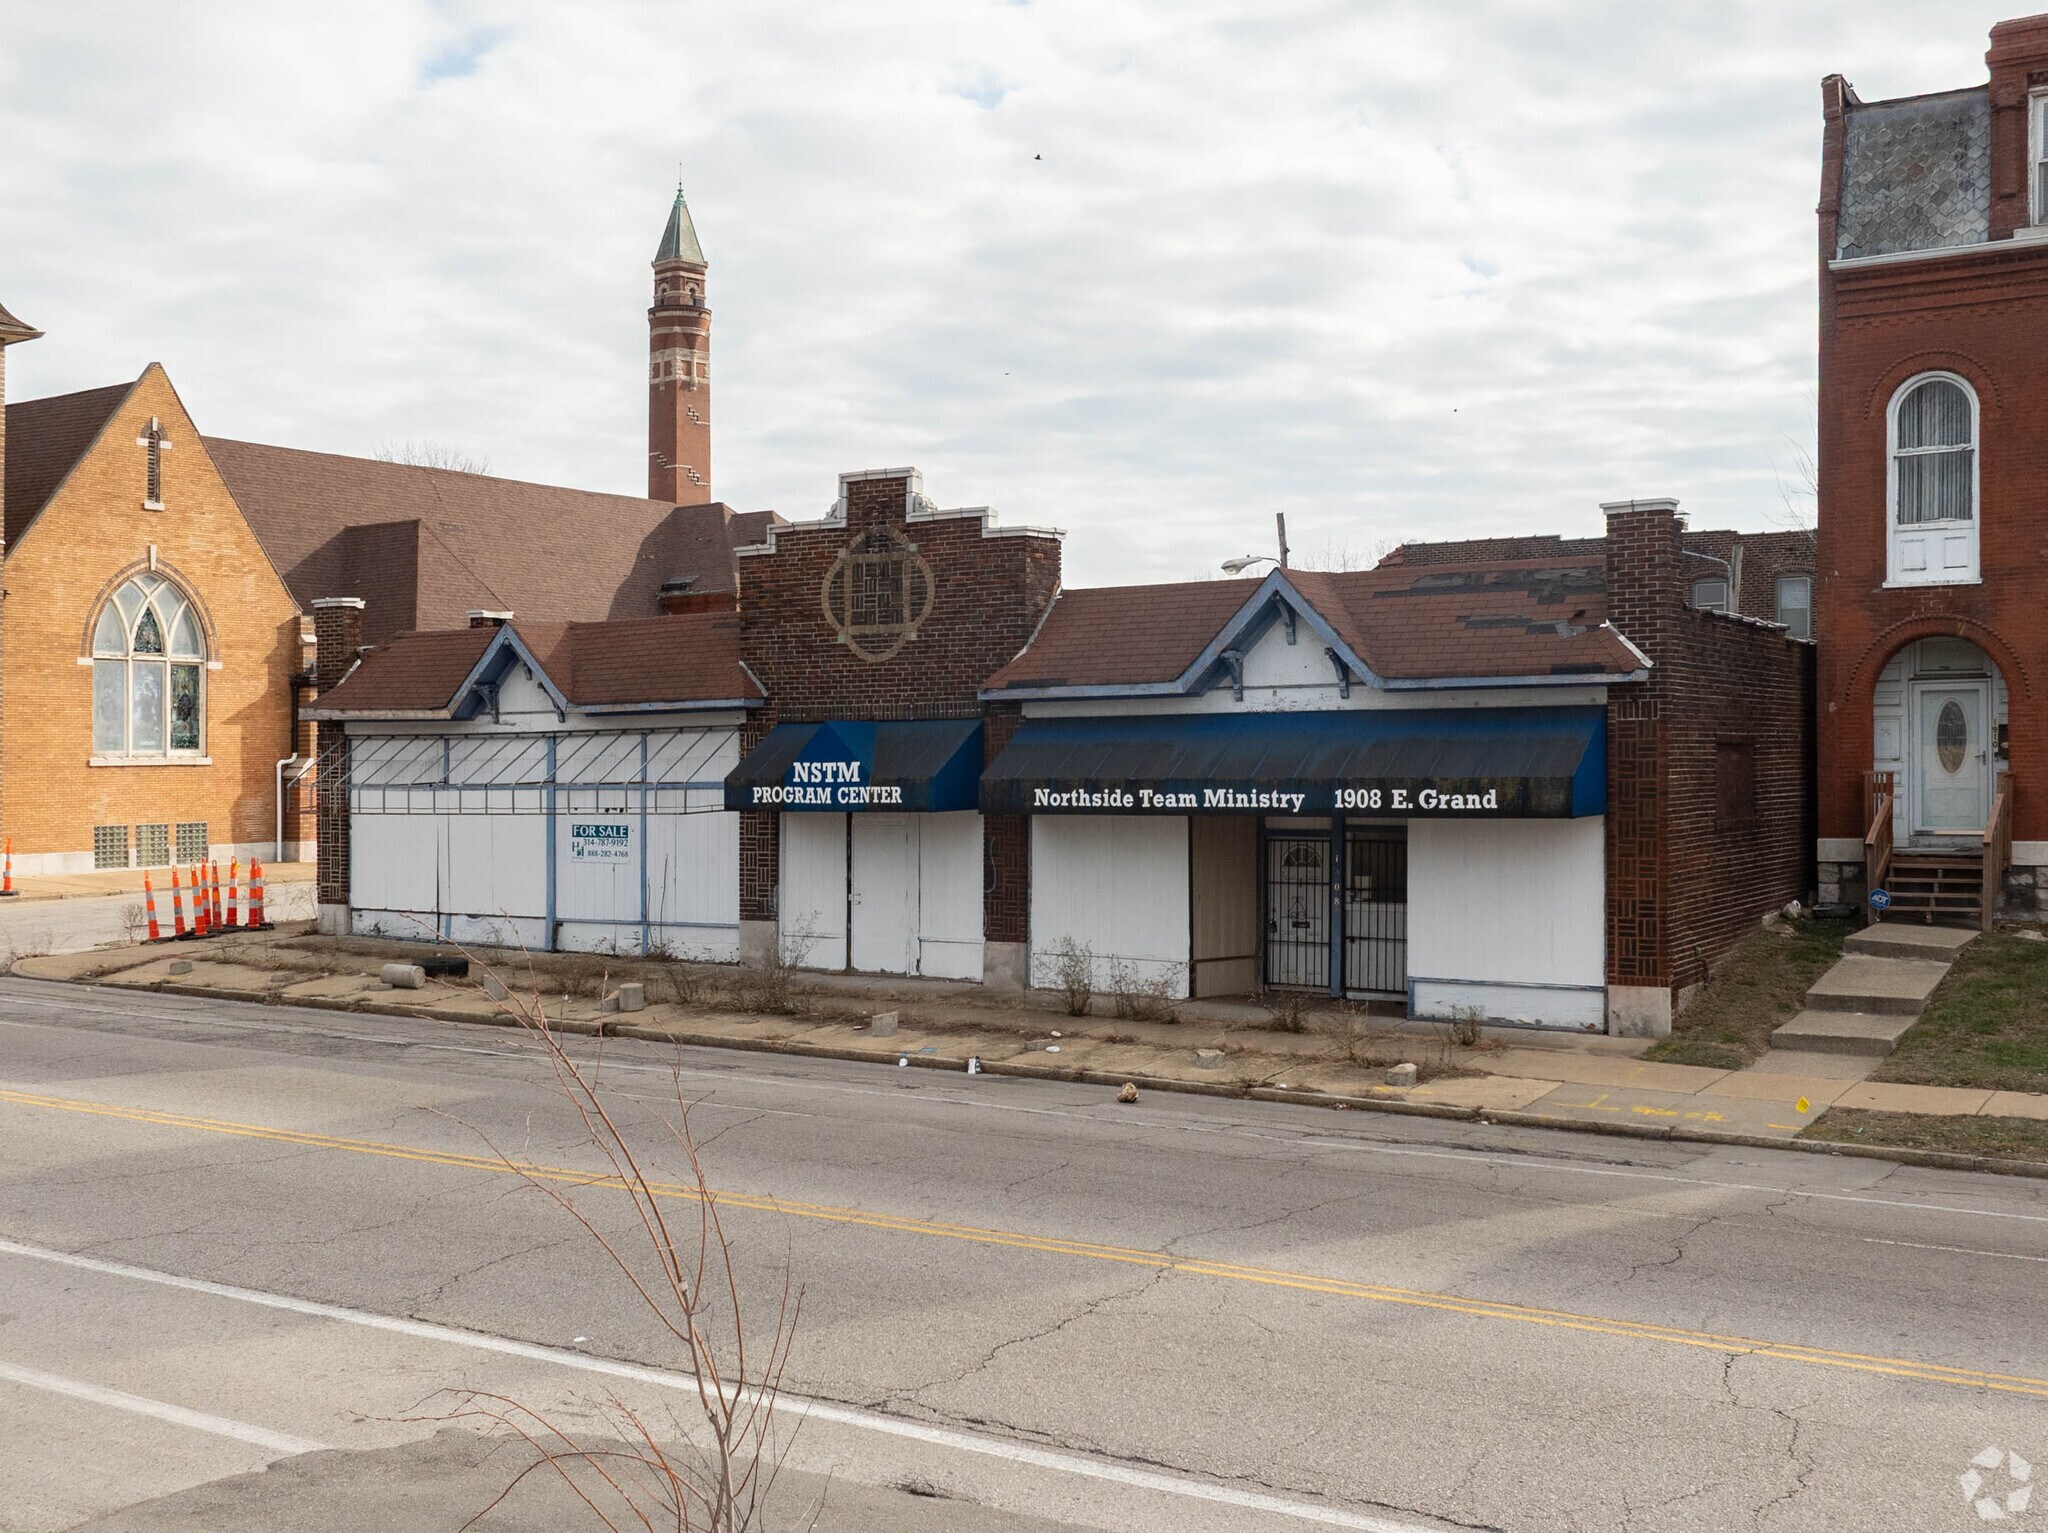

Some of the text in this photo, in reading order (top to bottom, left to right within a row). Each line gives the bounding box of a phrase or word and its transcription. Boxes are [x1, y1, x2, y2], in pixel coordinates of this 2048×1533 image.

[793, 761, 861, 782] NSTM
[753, 786, 903, 804] PROGRAM CENTER
[1034, 788, 1305, 813] Northside Team Ministry
[1335, 788, 1498, 810] 1908 E. Grand
[574, 826, 627, 837] FOR SALE
[583, 838, 628, 847] 314-787-9192
